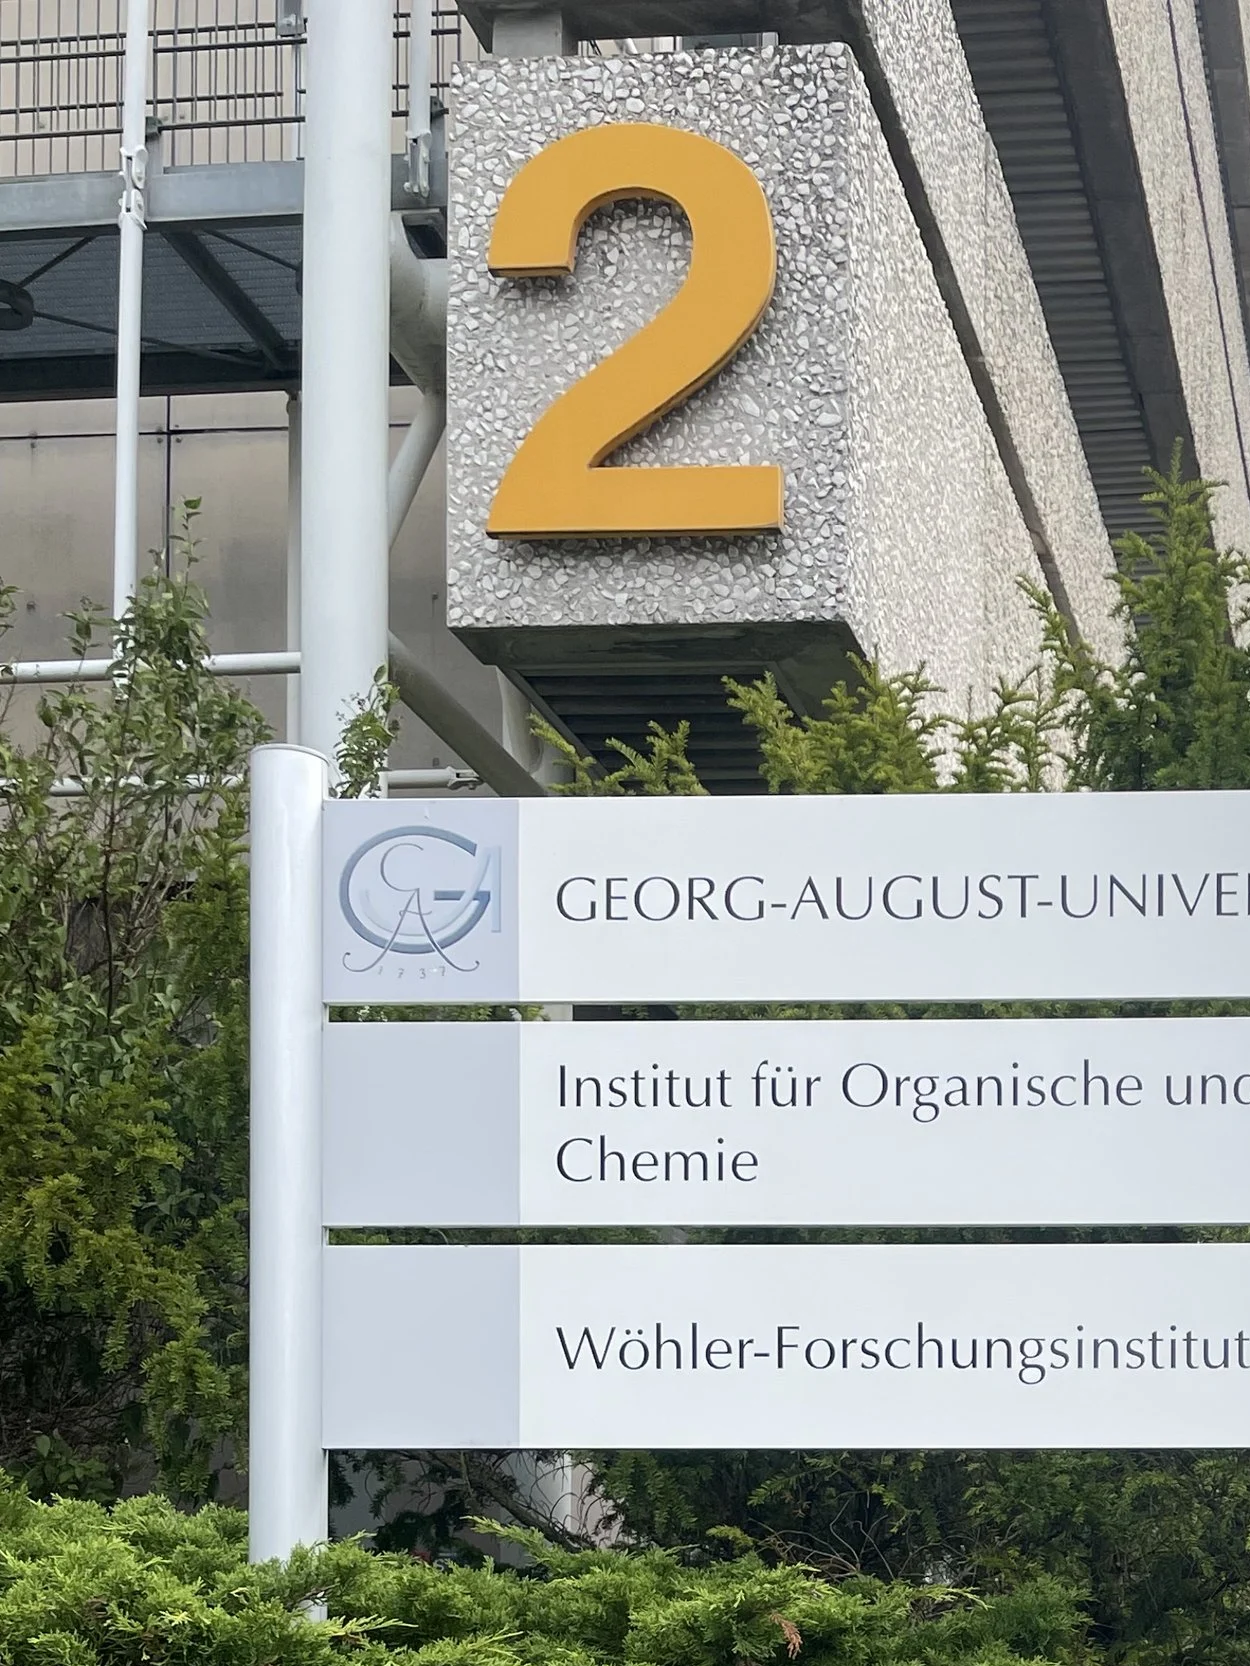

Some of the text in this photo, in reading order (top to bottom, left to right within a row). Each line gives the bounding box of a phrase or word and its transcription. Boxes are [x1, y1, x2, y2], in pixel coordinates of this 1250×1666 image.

[486, 123, 784, 540] 2
[559, 1063, 734, 1108] Institut
[751, 1060, 823, 1108] für
[842, 1059, 1144, 1124] Organische
[556, 1136, 760, 1184] Chemie
